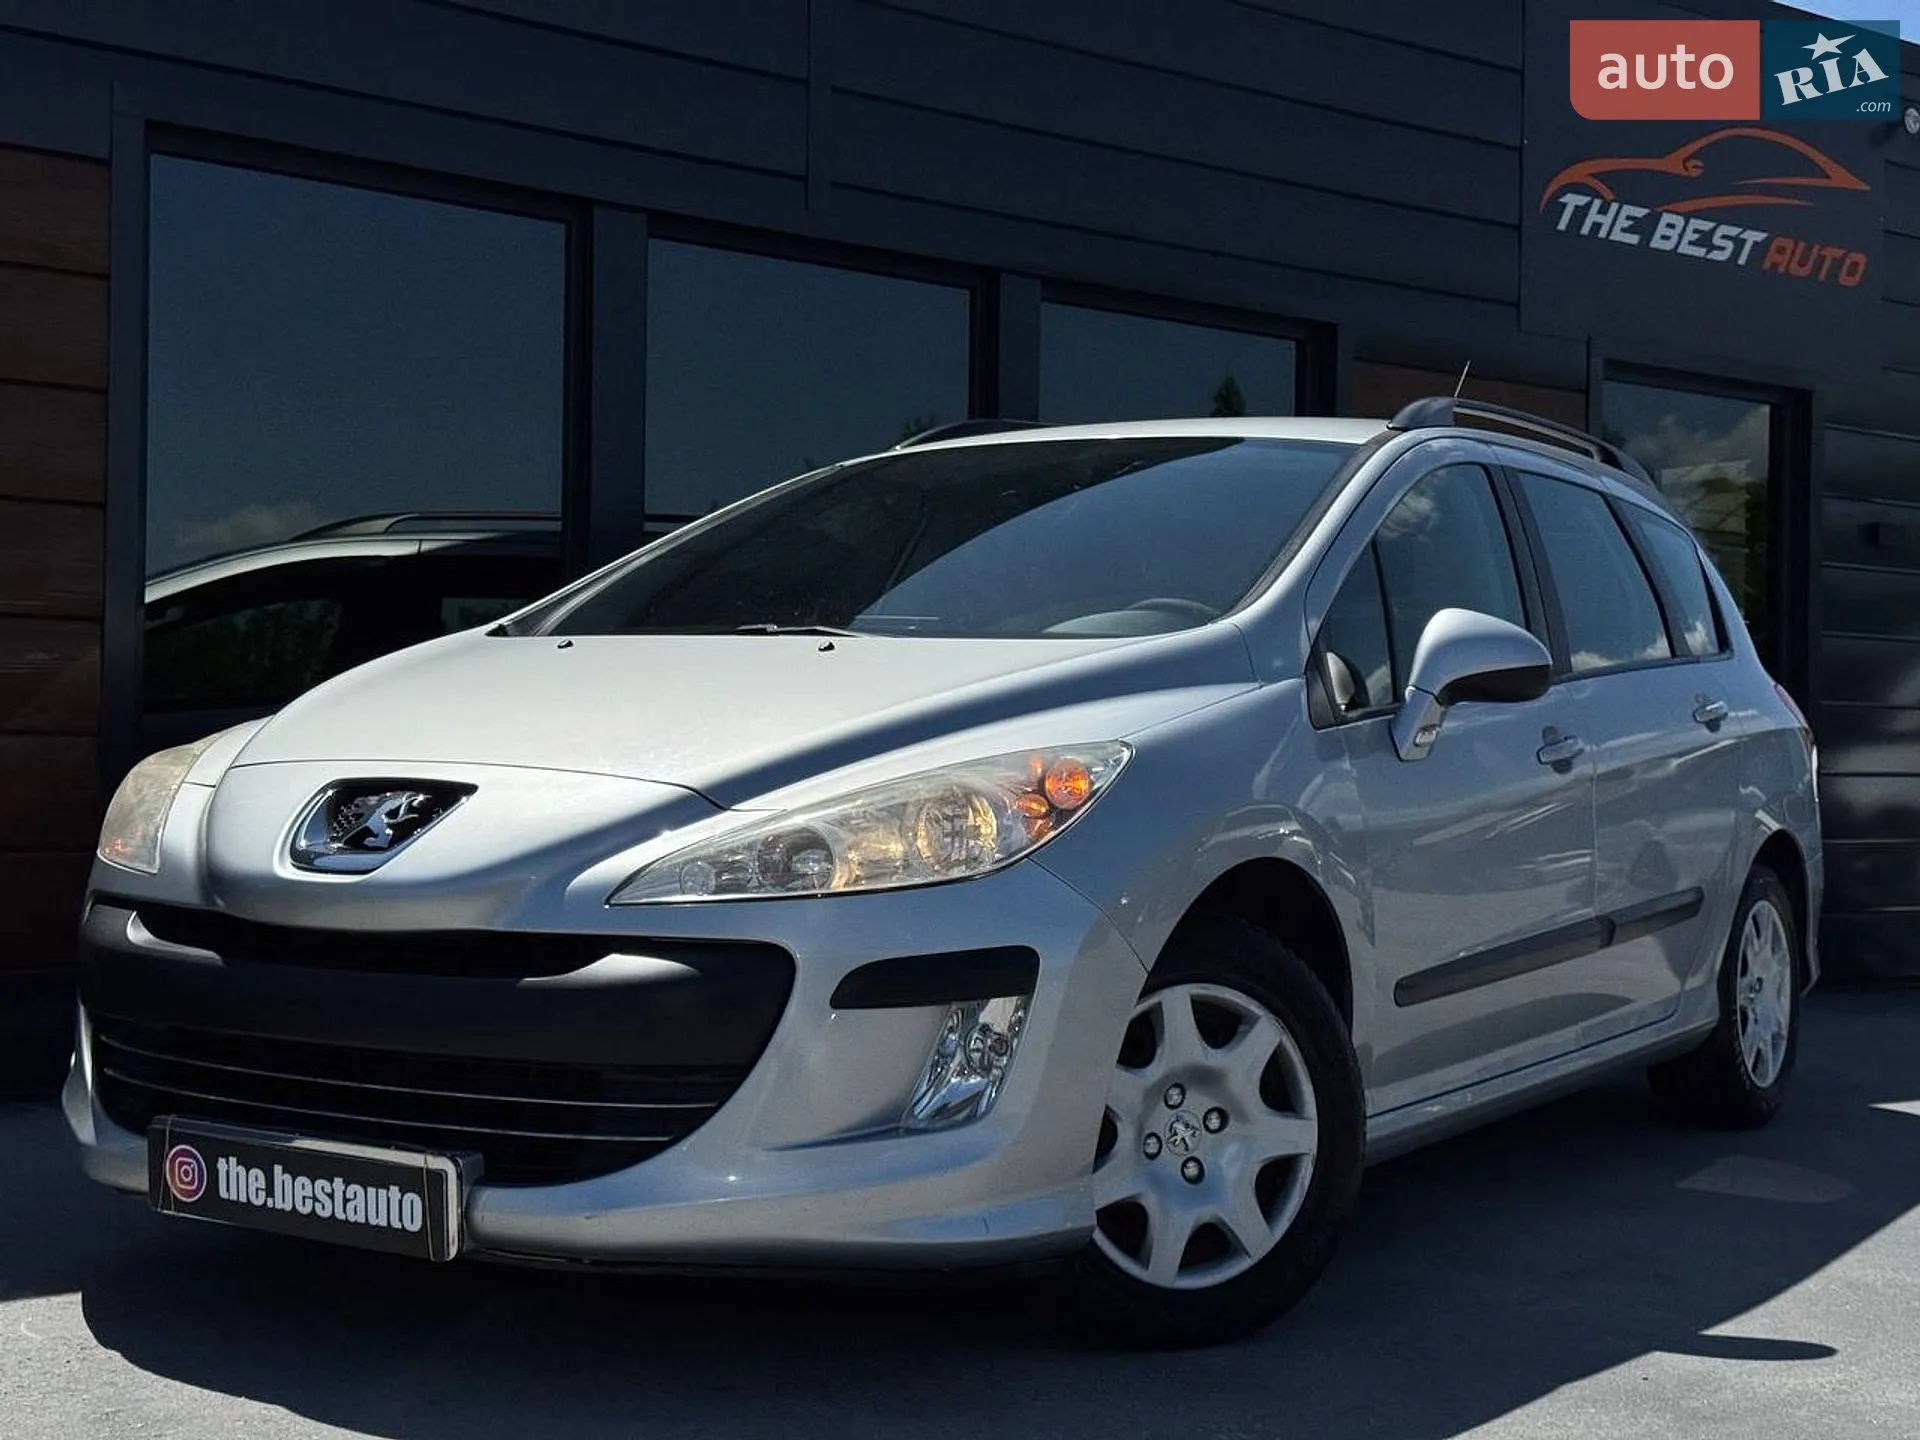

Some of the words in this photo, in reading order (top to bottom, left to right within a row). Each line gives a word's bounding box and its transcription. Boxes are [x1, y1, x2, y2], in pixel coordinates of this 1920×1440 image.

[1556, 193, 1650, 246] THE
[1649, 209, 1769, 266] BEST
[1763, 236, 1867, 287] AUTO
[217, 1156, 423, 1233] the.bestauto
